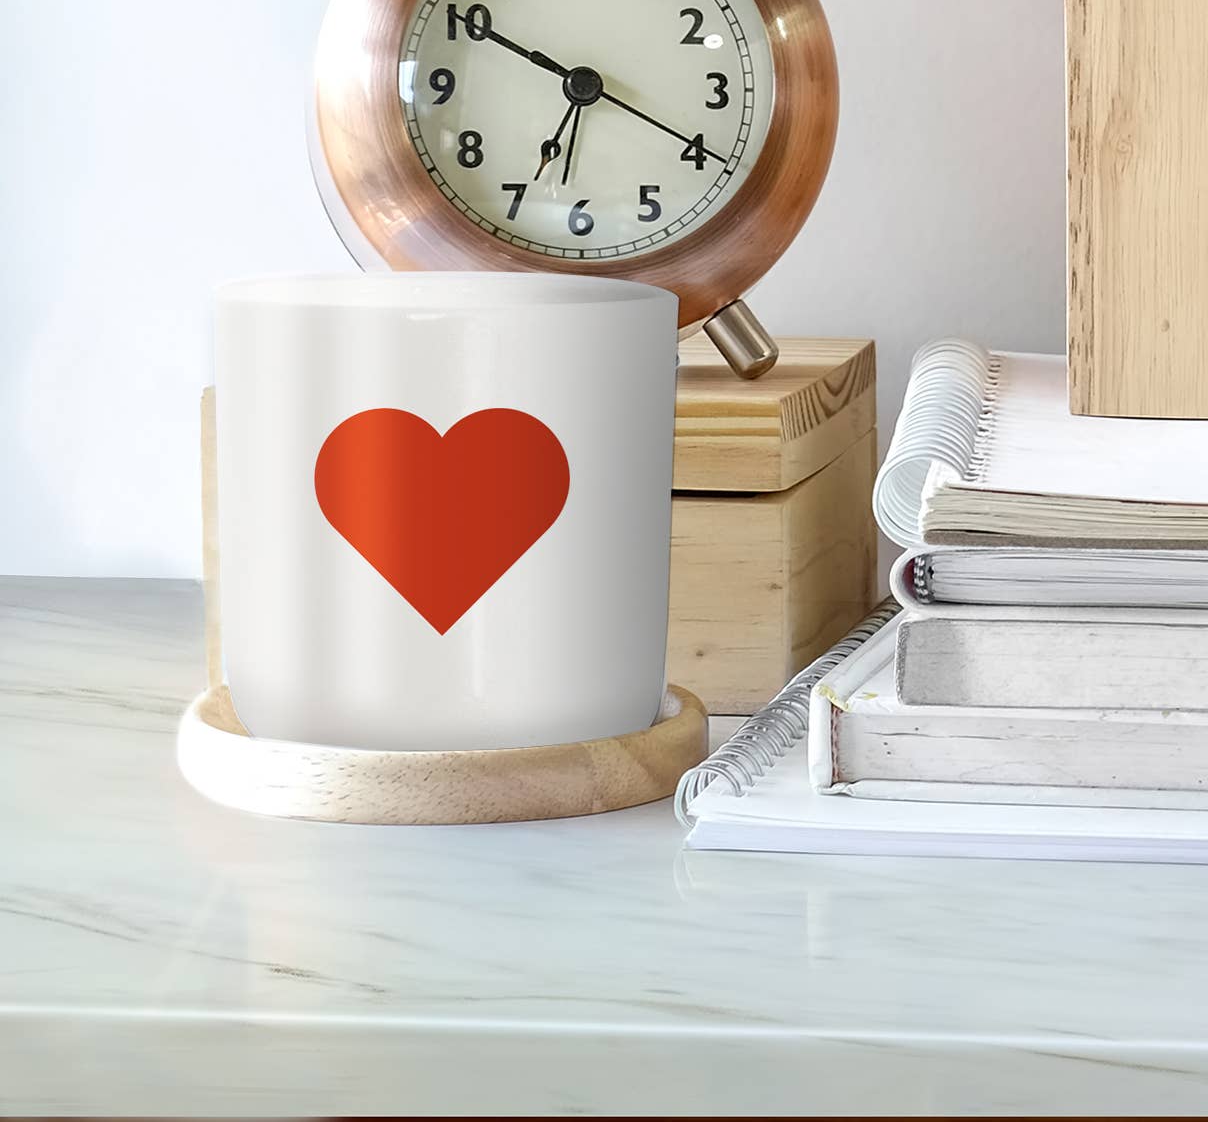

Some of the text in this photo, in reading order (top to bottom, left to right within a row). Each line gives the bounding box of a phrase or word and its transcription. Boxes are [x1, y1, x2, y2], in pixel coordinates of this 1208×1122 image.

[447, 4, 492, 41] 10
[679, 8, 706, 45] 2
[428, 68, 456, 105] 9
[705, 72, 729, 109] 3
[457, 131, 484, 168] 8
[680, 133, 707, 170] 4
[501, 183, 527, 221] 7
[567, 199, 595, 236] 6
[637, 185, 662, 222] 5
